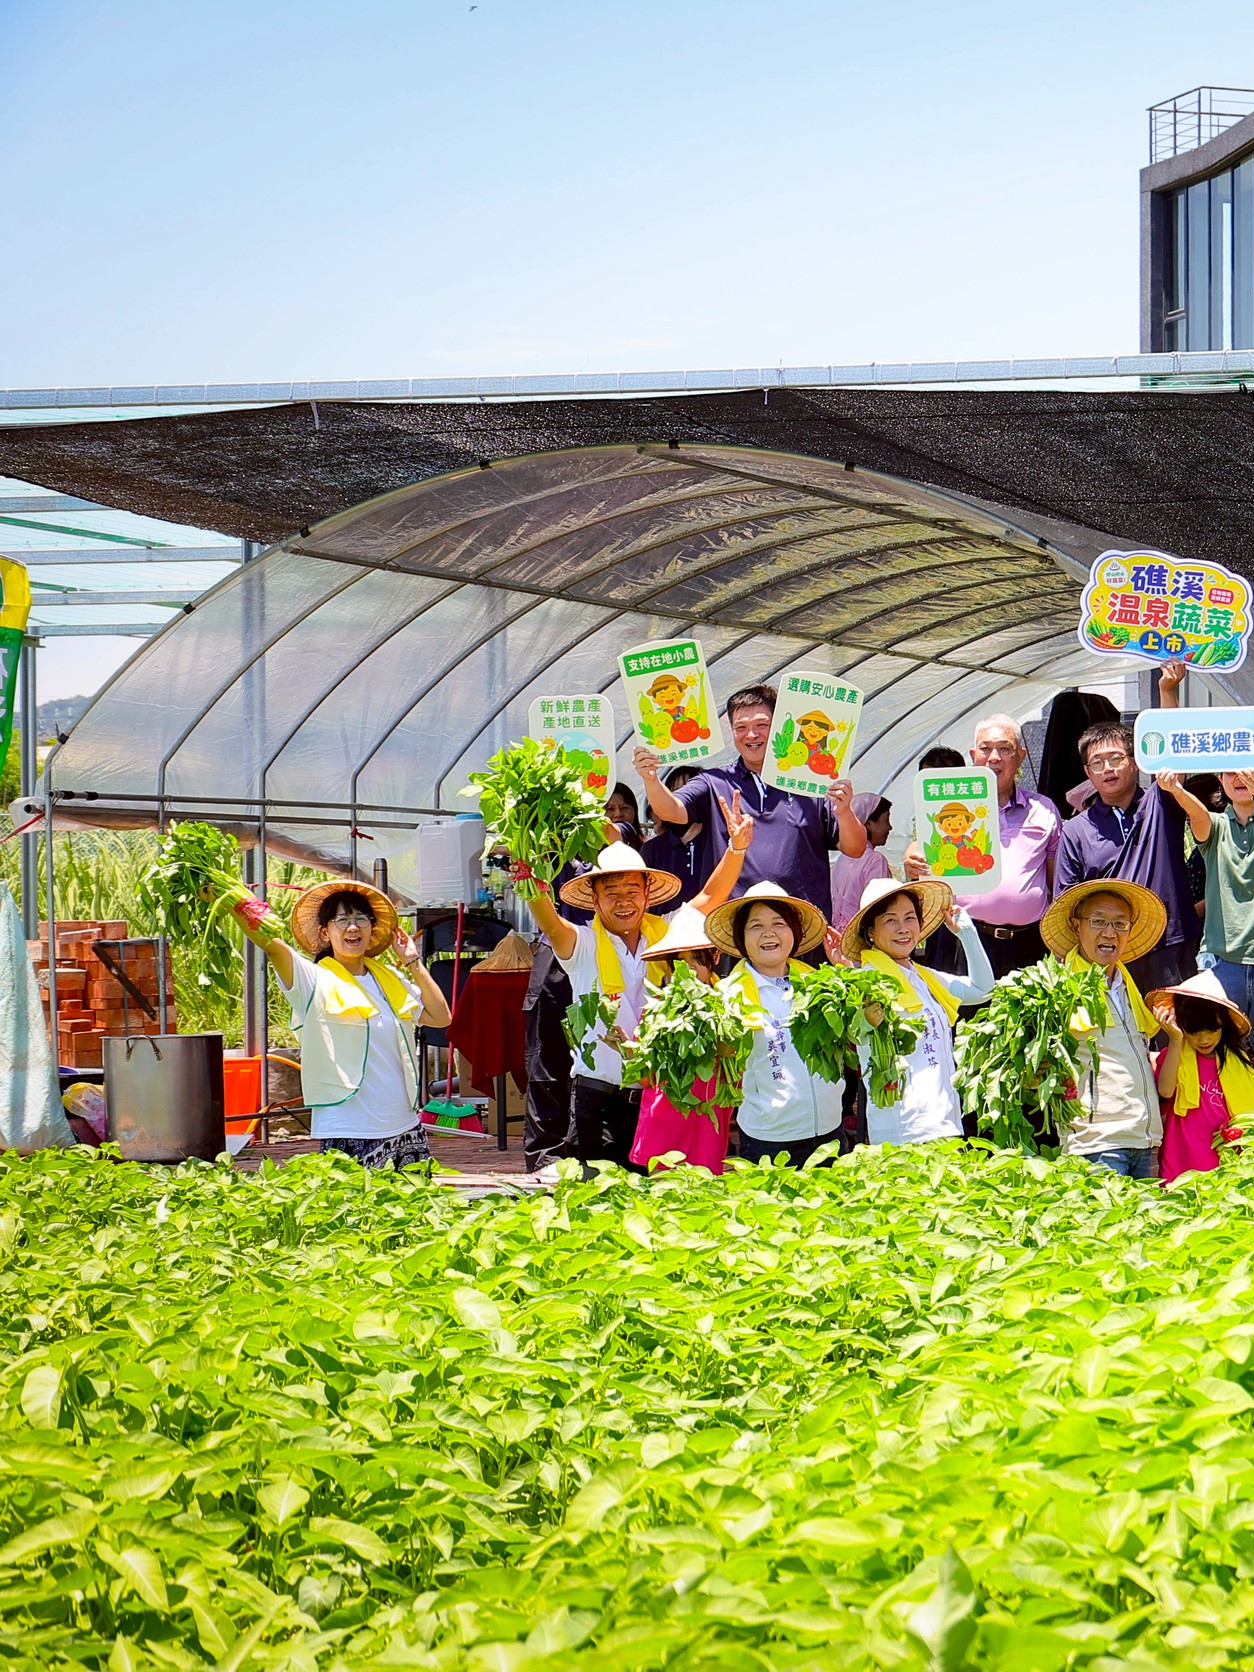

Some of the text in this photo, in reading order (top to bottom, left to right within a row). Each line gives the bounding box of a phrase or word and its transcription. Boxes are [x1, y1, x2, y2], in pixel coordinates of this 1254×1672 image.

[1130, 564, 1205, 602] 礁溪
[1107, 593, 1236, 640] 溫泉蔬菜
[1142, 632, 1184, 654] 上市
[627, 647, 696, 672] 支持在地小農
[787, 677, 859, 704] 選購安心農產
[540, 699, 602, 713] 新鮮農產
[543, 714, 601, 729] 產地直送
[927, 781, 984, 797] 有機友善
